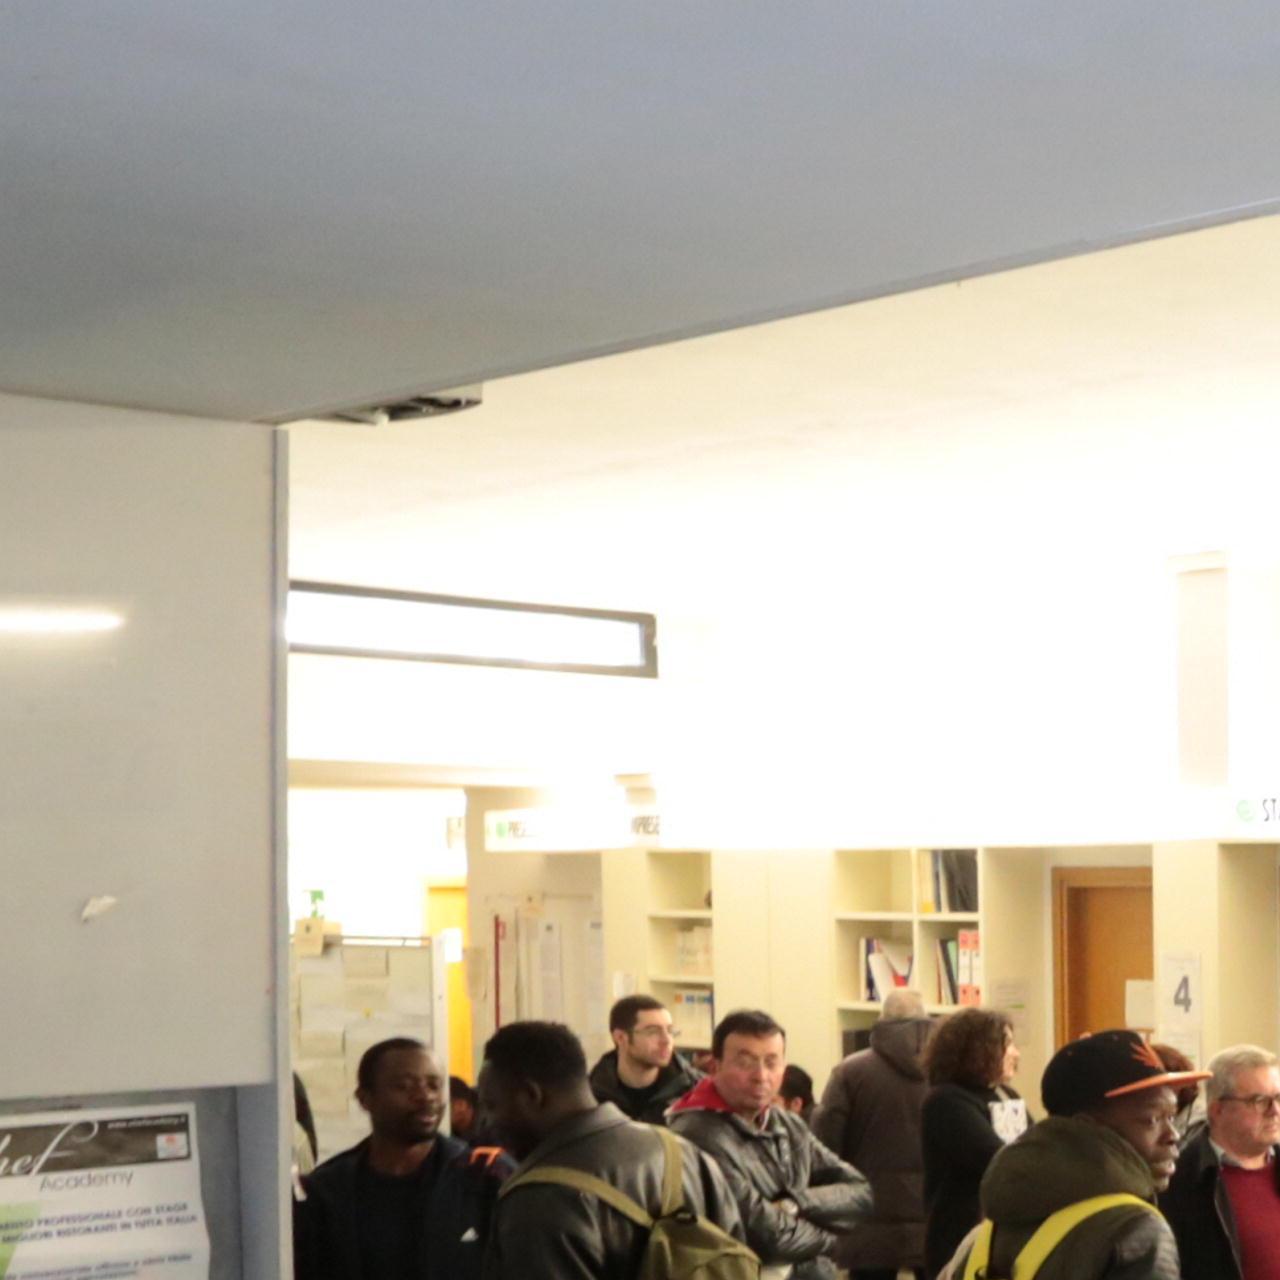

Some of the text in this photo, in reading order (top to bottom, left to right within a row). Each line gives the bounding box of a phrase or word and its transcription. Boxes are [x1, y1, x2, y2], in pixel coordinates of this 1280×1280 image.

[1173, 975, 1192, 1013] 4
[40, 1170, 135, 1192] Academy
[37, 1210, 122, 1227] PROFESSIONALE
[126, 1207, 152, 1218] CON
[56, 1225, 118, 1239] RISTORANTI
[134, 1219, 163, 1231] TUTTA
